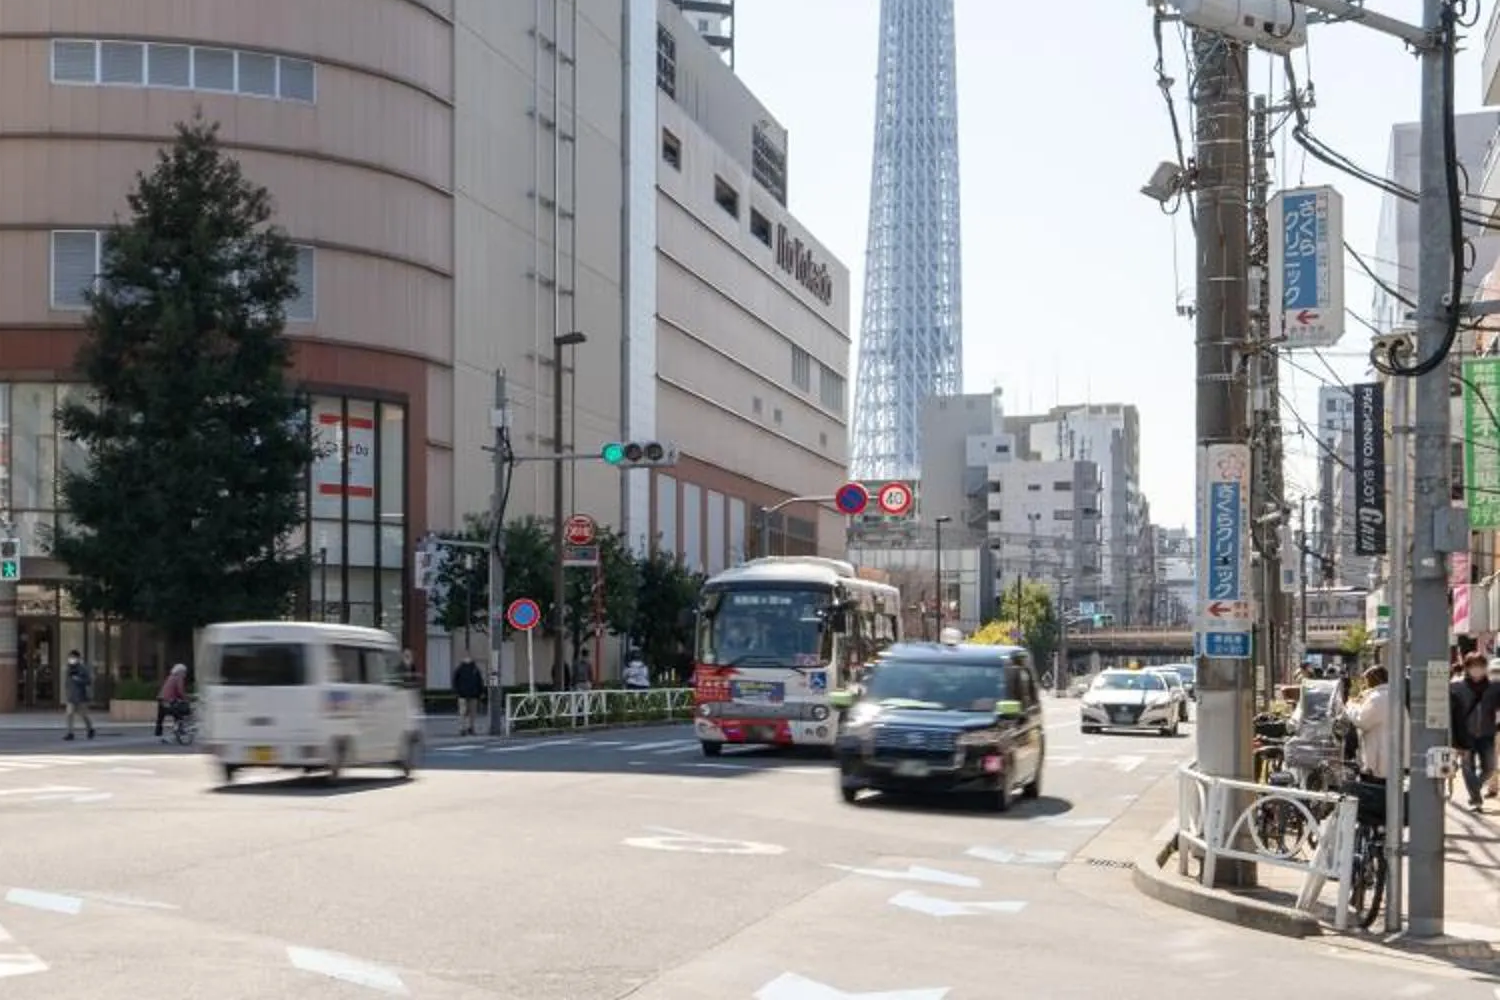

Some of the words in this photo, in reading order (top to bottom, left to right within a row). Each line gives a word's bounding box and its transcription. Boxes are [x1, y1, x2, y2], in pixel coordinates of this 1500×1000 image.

[1284, 211, 1301, 306] クリニック
[1299, 199, 1316, 257] さくら
[776, 222, 794, 275] Ito
[794, 236, 833, 307] Yokado
[886, 491, 904, 505] 40
